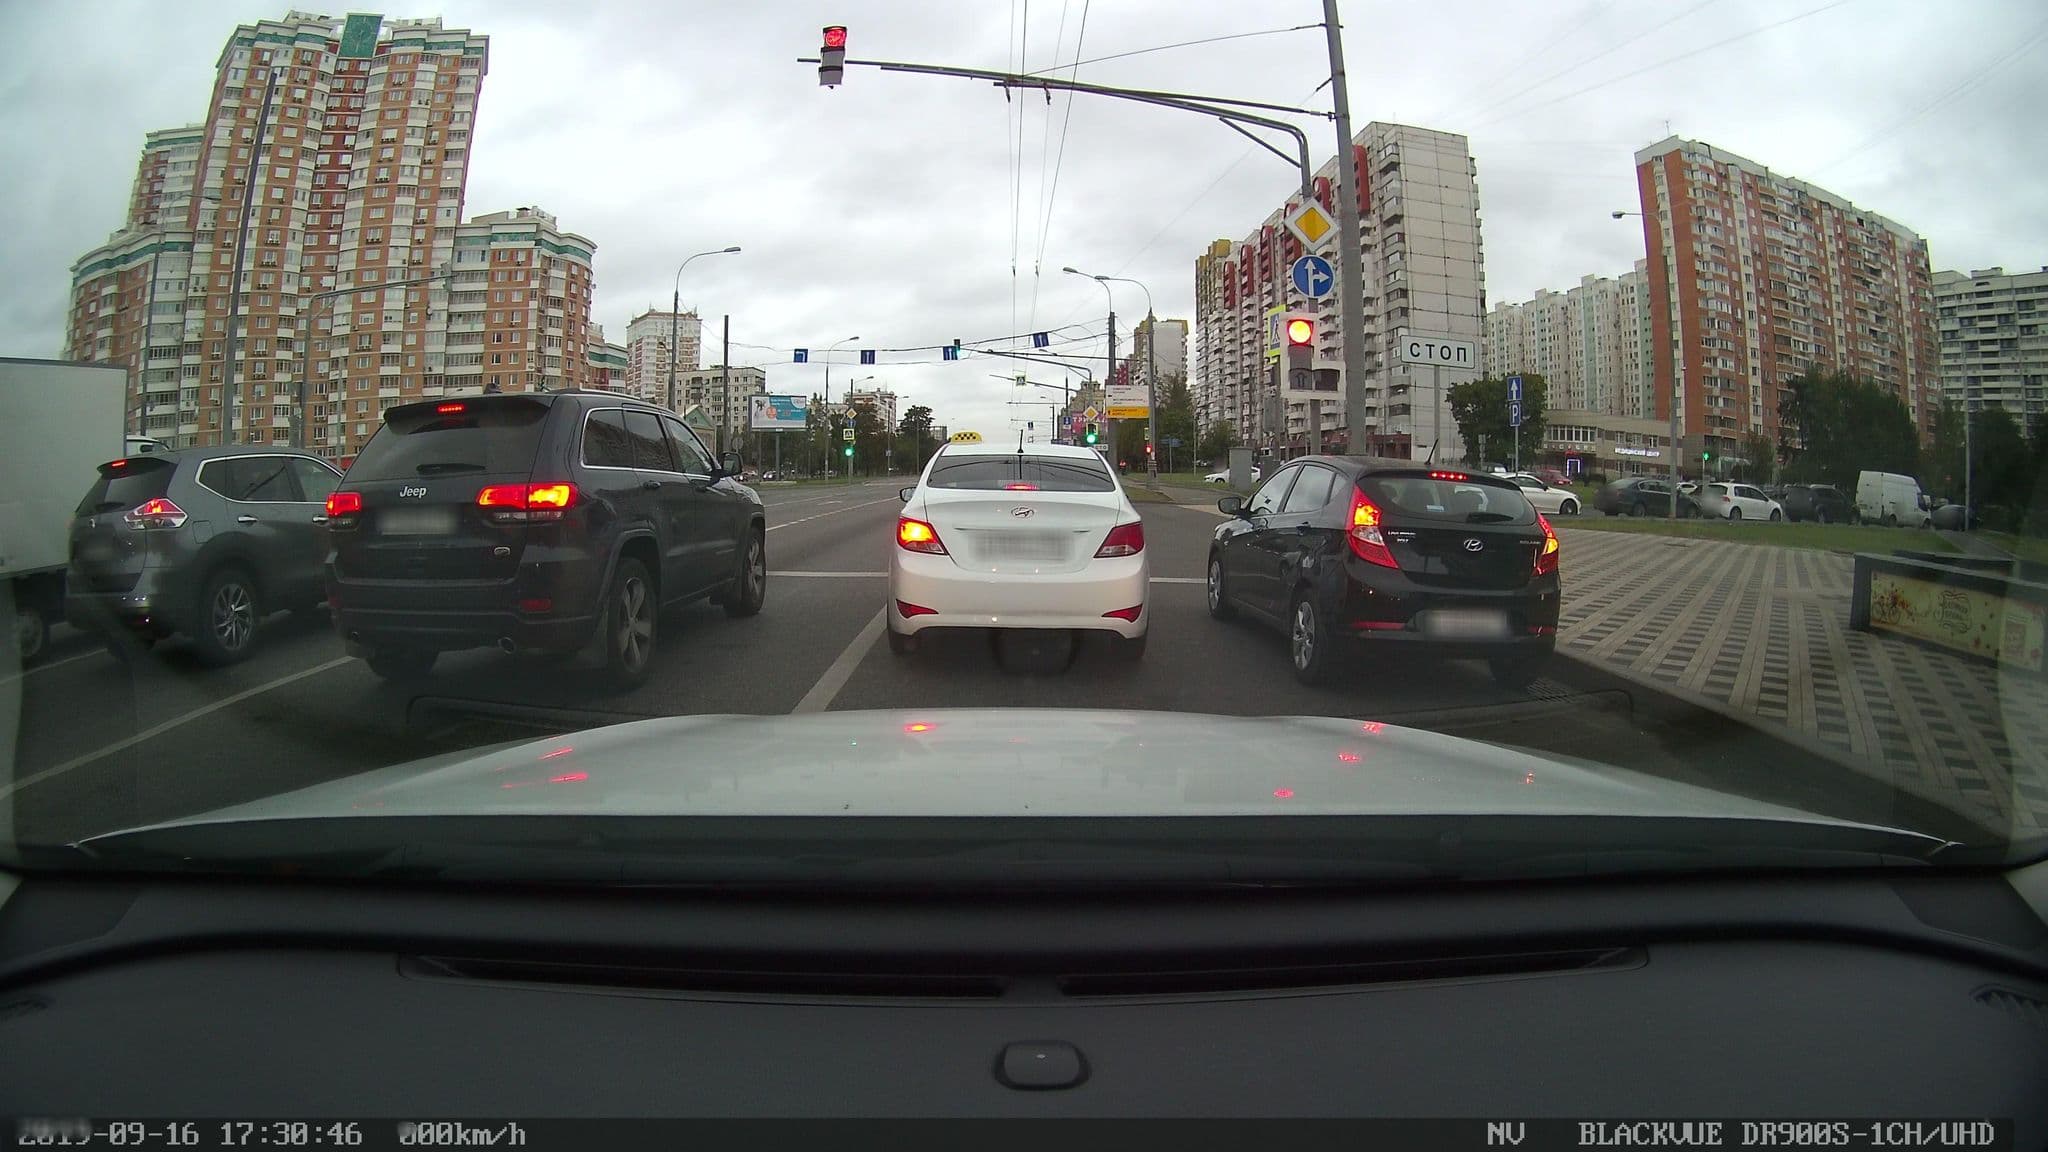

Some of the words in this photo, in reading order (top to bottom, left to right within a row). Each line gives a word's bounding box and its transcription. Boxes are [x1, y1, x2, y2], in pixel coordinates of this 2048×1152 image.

[1409, 342, 1467, 363] СТОП
[1512, 404, 1519, 424] P
[399, 485, 428, 499] Jeep
